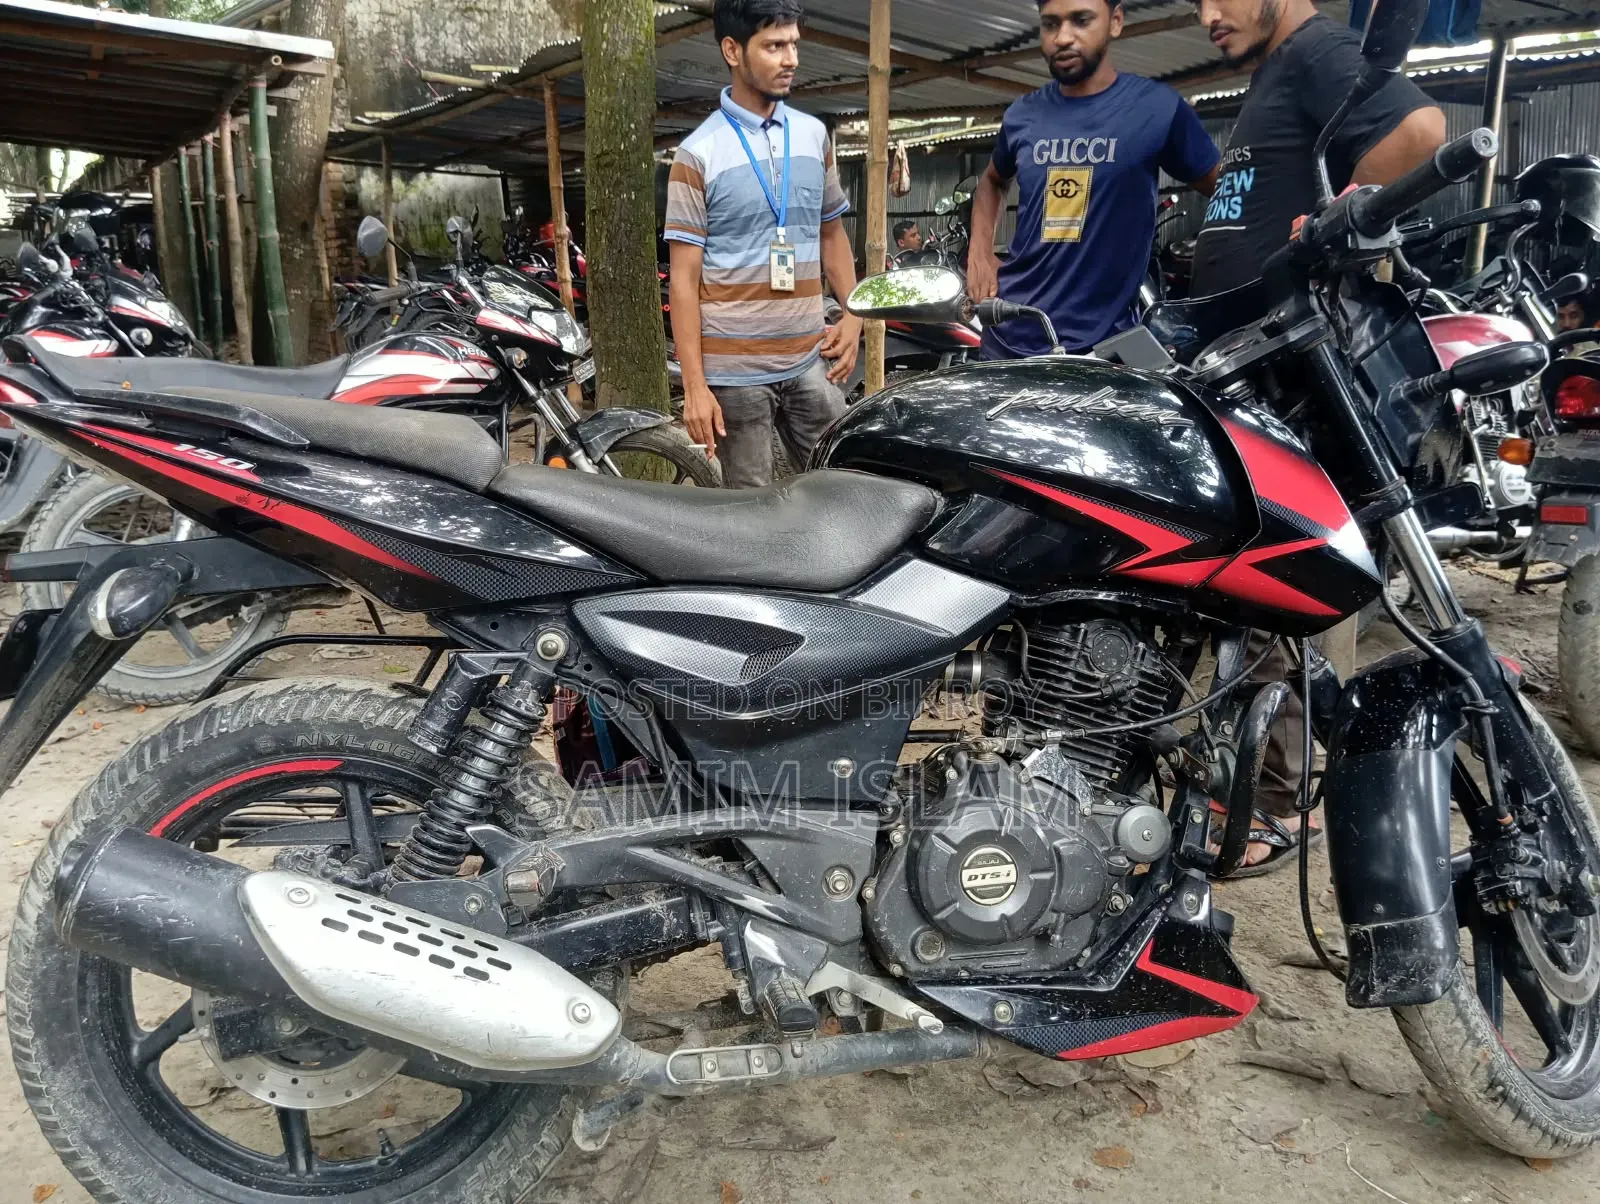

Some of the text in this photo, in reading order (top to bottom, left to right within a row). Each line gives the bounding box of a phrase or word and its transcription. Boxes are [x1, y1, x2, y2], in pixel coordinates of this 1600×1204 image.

[1032, 137, 1118, 165] GUCCI
[458, 346, 489, 359] Hero
[171, 443, 255, 470] 150
